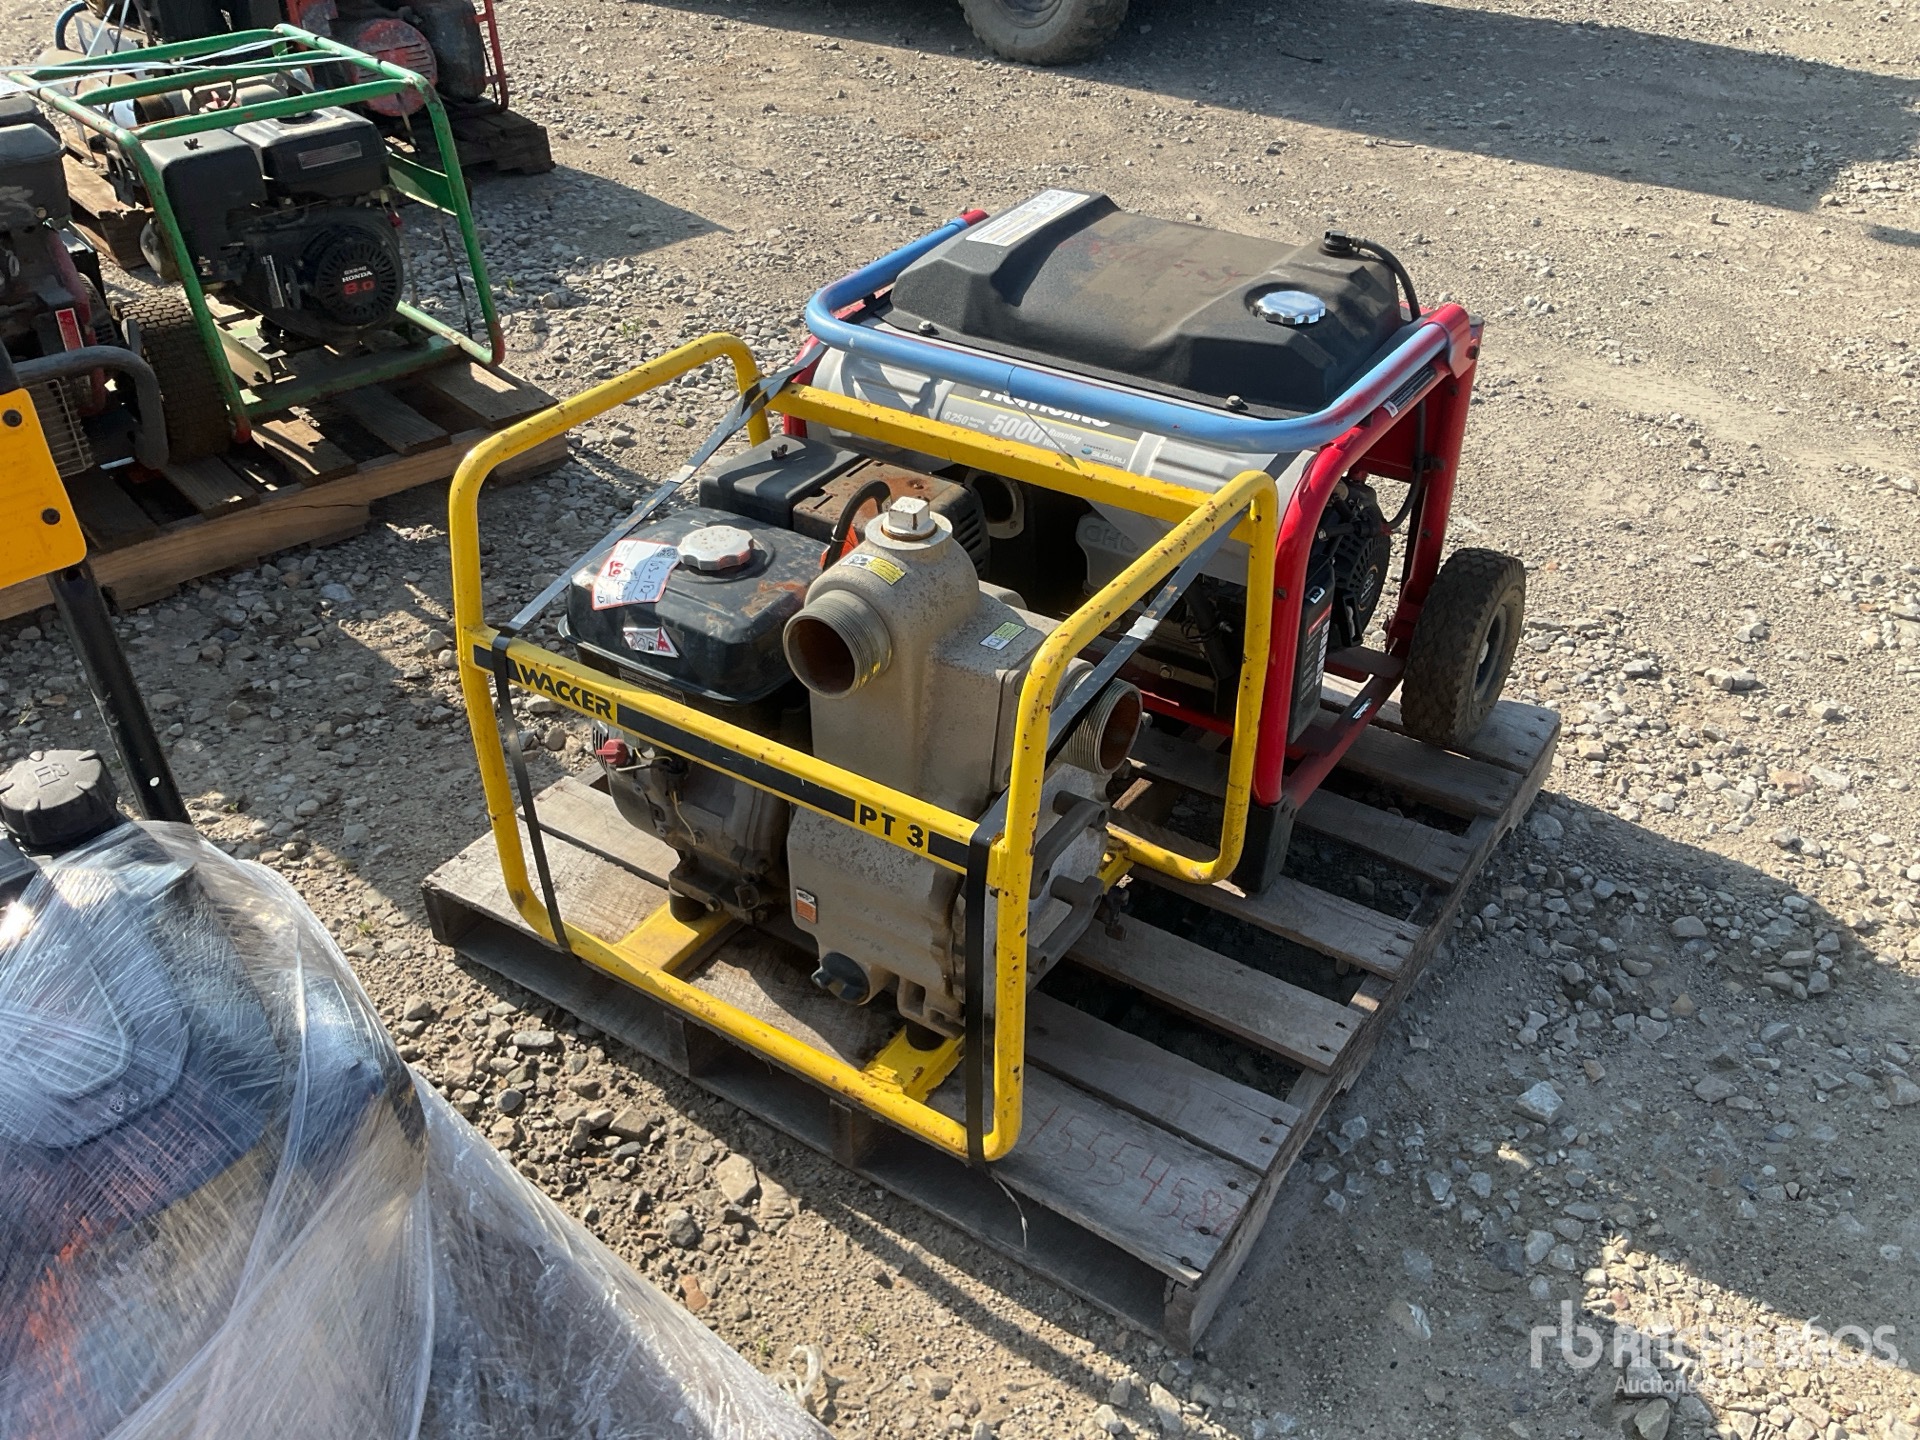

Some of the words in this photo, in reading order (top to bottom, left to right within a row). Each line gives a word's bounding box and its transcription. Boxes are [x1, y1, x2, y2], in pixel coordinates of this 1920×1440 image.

[341, 270, 373, 282] HONDA
[943, 411, 969, 425] 6250
[988, 413, 1048, 444] 5000
[1048, 427, 1082, 445] Running
[1091, 449, 1127, 465] SUBARU
[519, 663, 612, 720] WACKER
[860, 804, 896, 837] PT
[907, 823, 924, 848] 3
